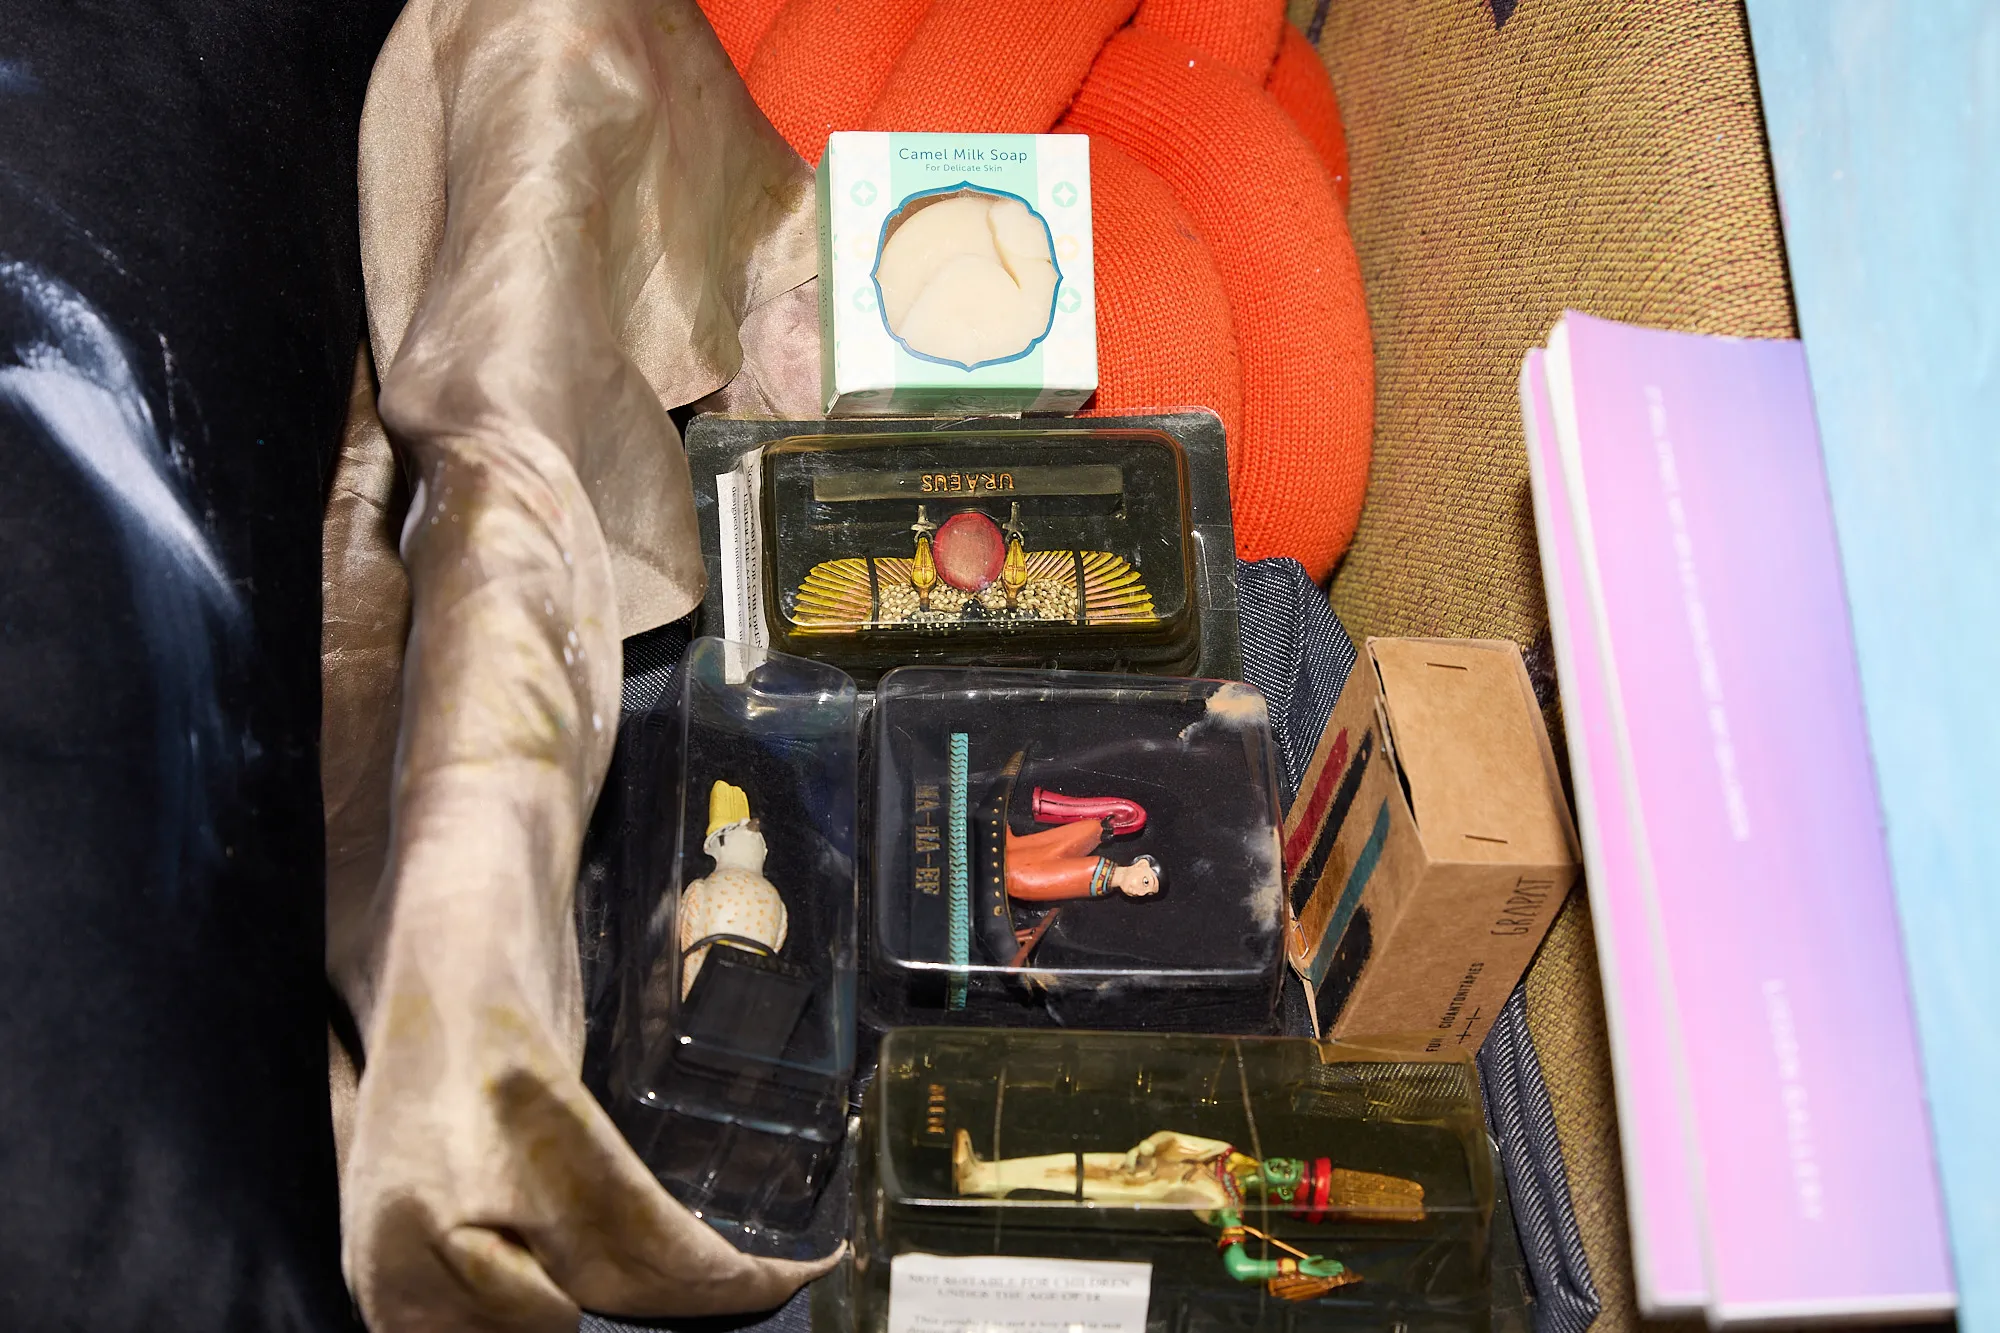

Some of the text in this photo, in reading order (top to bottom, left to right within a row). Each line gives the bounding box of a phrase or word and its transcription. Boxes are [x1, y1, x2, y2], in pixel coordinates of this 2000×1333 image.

[898, 147, 1028, 164] Camel Milk Soap
[925, 163, 1003, 173] For Delicate Skin
[920, 472, 1015, 493] URAEUS
[1490, 876, 1556, 937] GRAPAT
